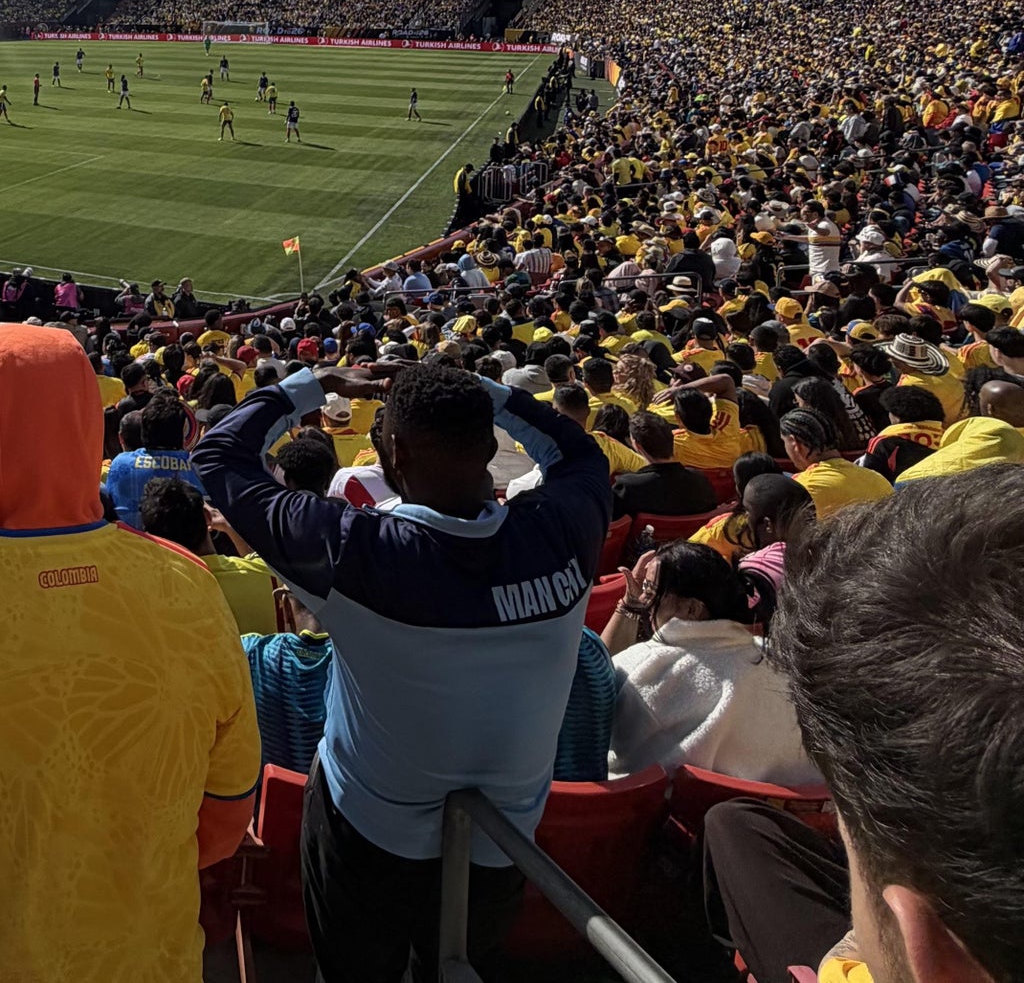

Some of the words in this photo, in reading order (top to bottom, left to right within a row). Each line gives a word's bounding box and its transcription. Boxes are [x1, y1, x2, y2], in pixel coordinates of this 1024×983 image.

[330, 38, 360, 46] TURKISH
[361, 39, 392, 47] AIRLINES
[416, 41, 447, 49] TURKISH
[447, 42, 481, 50] AIRLINES
[719, 140, 727, 151] 10
[39, 565, 98, 589] COLOMBIA
[491, 576, 557, 622] MAN
